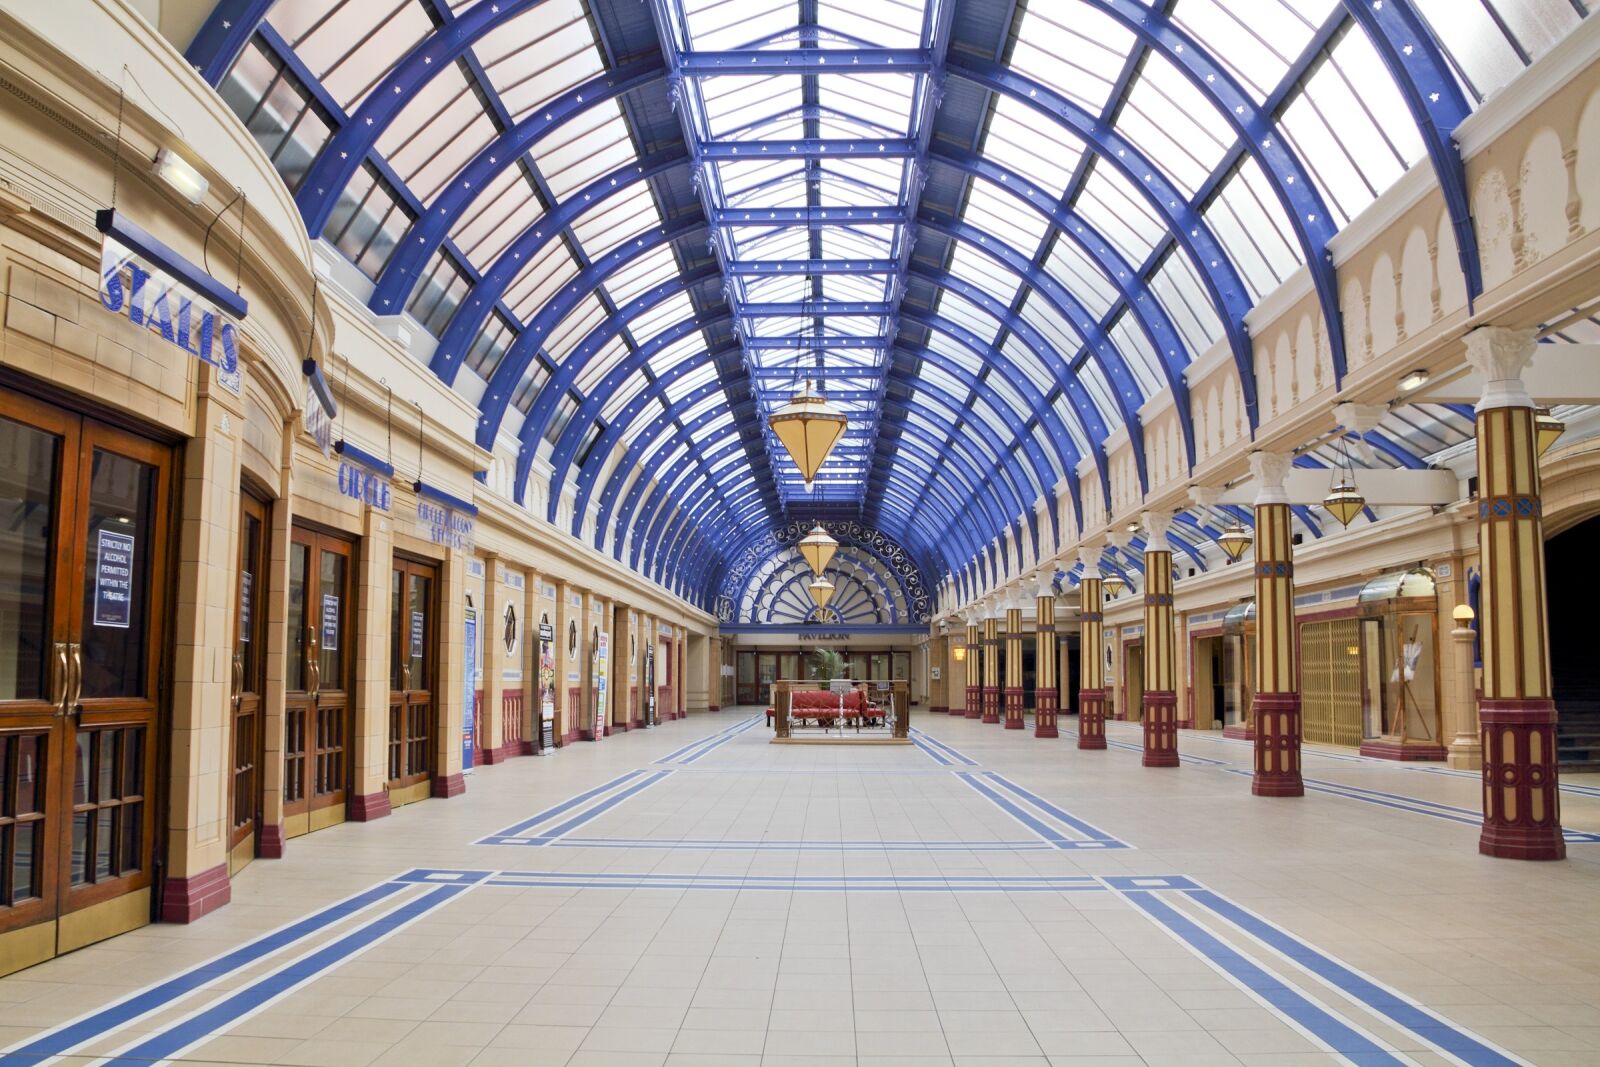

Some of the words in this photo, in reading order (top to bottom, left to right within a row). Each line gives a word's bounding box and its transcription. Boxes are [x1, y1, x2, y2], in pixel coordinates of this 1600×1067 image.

[101, 252, 238, 374] STALLS
[338, 462, 390, 512] CIRCLE
[101, 539, 121, 549] STRICTLY
[123, 543, 131, 551] NO
[104, 553, 127, 563] ALCOHOL
[101, 565, 128, 576] PERMITTED
[100, 578, 118, 588] WITHIN
[119, 580, 128, 589] THE
[103, 591, 125, 601] THEATRE
